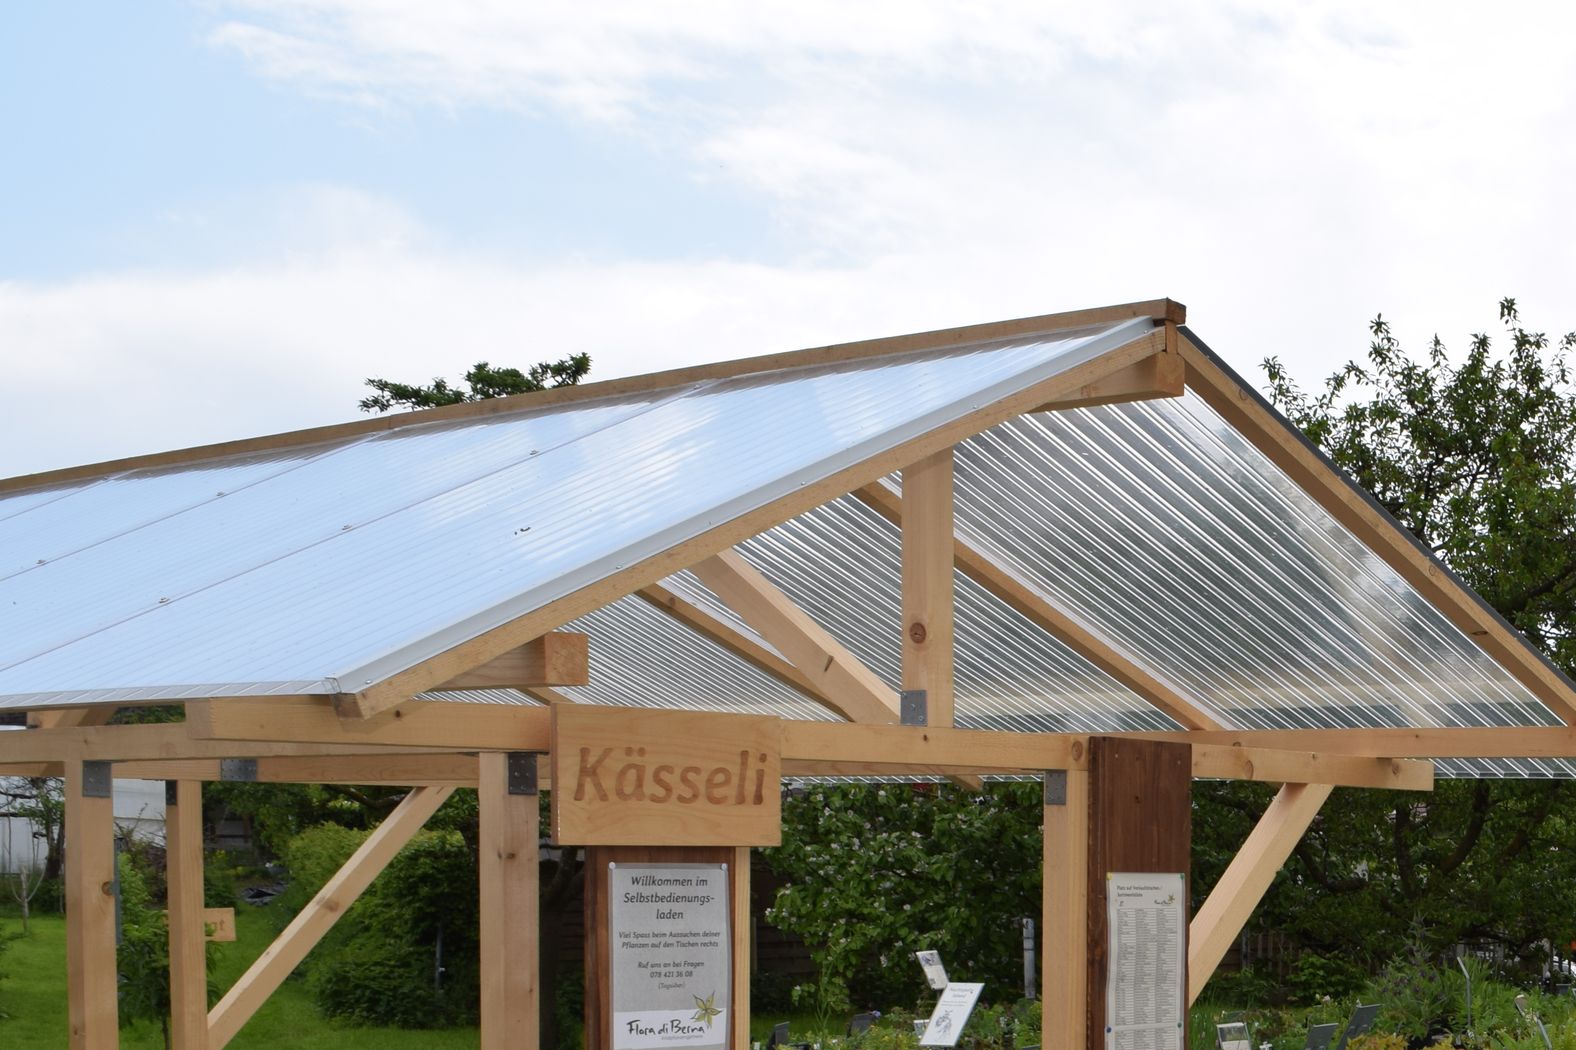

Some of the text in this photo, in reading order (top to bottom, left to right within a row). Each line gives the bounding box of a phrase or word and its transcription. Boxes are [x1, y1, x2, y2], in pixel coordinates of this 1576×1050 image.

[573, 747, 767, 806] Kässeli
[630, 875, 708, 888] Willkommen im
[623, 892, 715, 906] Selbstbedienungs-
[656, 908, 684, 920] laden
[621, 940, 649, 950] Pflanzen
[626, 1019, 656, 1036] Flora
